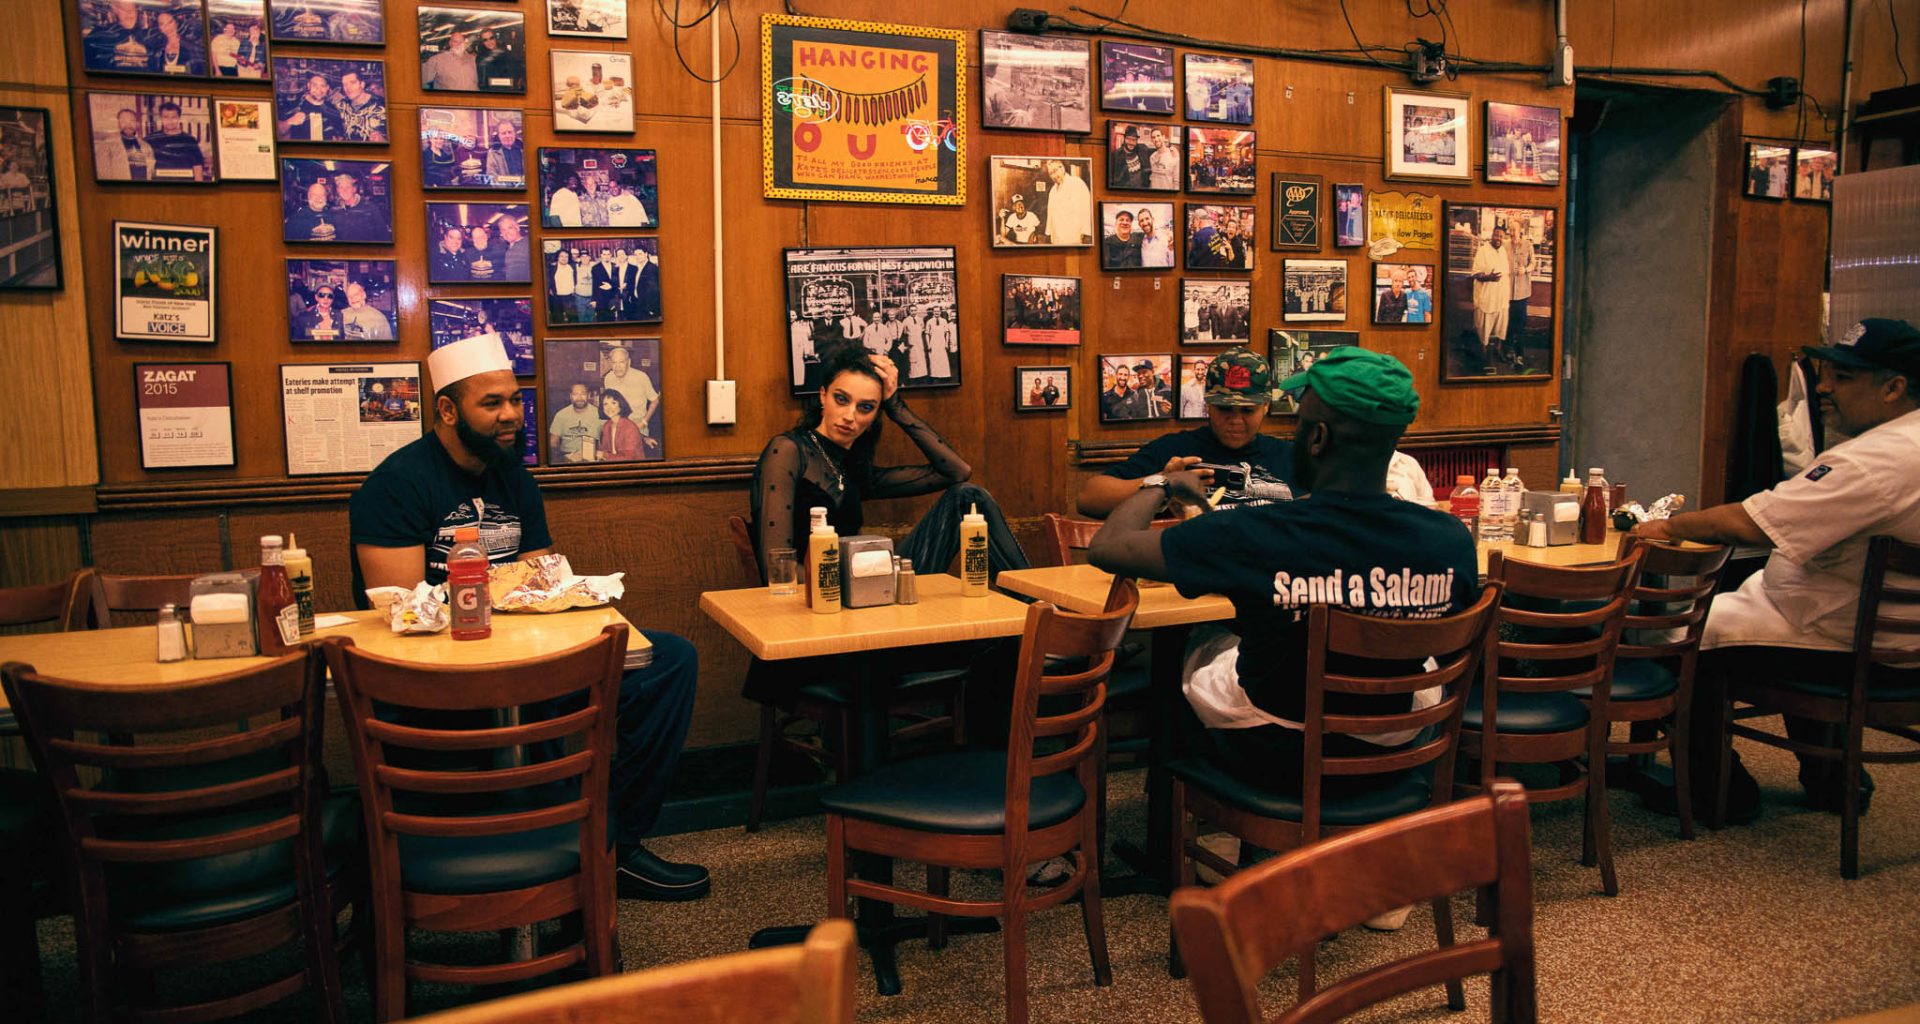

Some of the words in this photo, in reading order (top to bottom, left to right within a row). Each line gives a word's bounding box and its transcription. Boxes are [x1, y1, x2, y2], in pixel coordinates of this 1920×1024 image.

[799, 46, 929, 74] HANGING
[811, 157, 827, 165] ALL
[121, 231, 209, 253] winner
[790, 264, 810, 274] ARE
[811, 263, 847, 273] FAMOUS
[847, 262, 863, 271] FOR
[903, 260, 943, 271] SANDWICH
[148, 322, 185, 334] VOICE
[143, 370, 197, 382] ZAGAT
[285, 378, 311, 387] Eateries
[312, 378, 329, 386] make
[330, 377, 356, 386] attempt
[144, 383, 178, 395] 2015
[286, 387, 294, 395] at
[294, 386, 310, 395] shelf
[311, 386, 343, 395] promotion
[1273, 569, 1343, 605] Send
[1348, 574, 1365, 607] a
[1369, 566, 1454, 607] Salami
[456, 587, 478, 610] G
